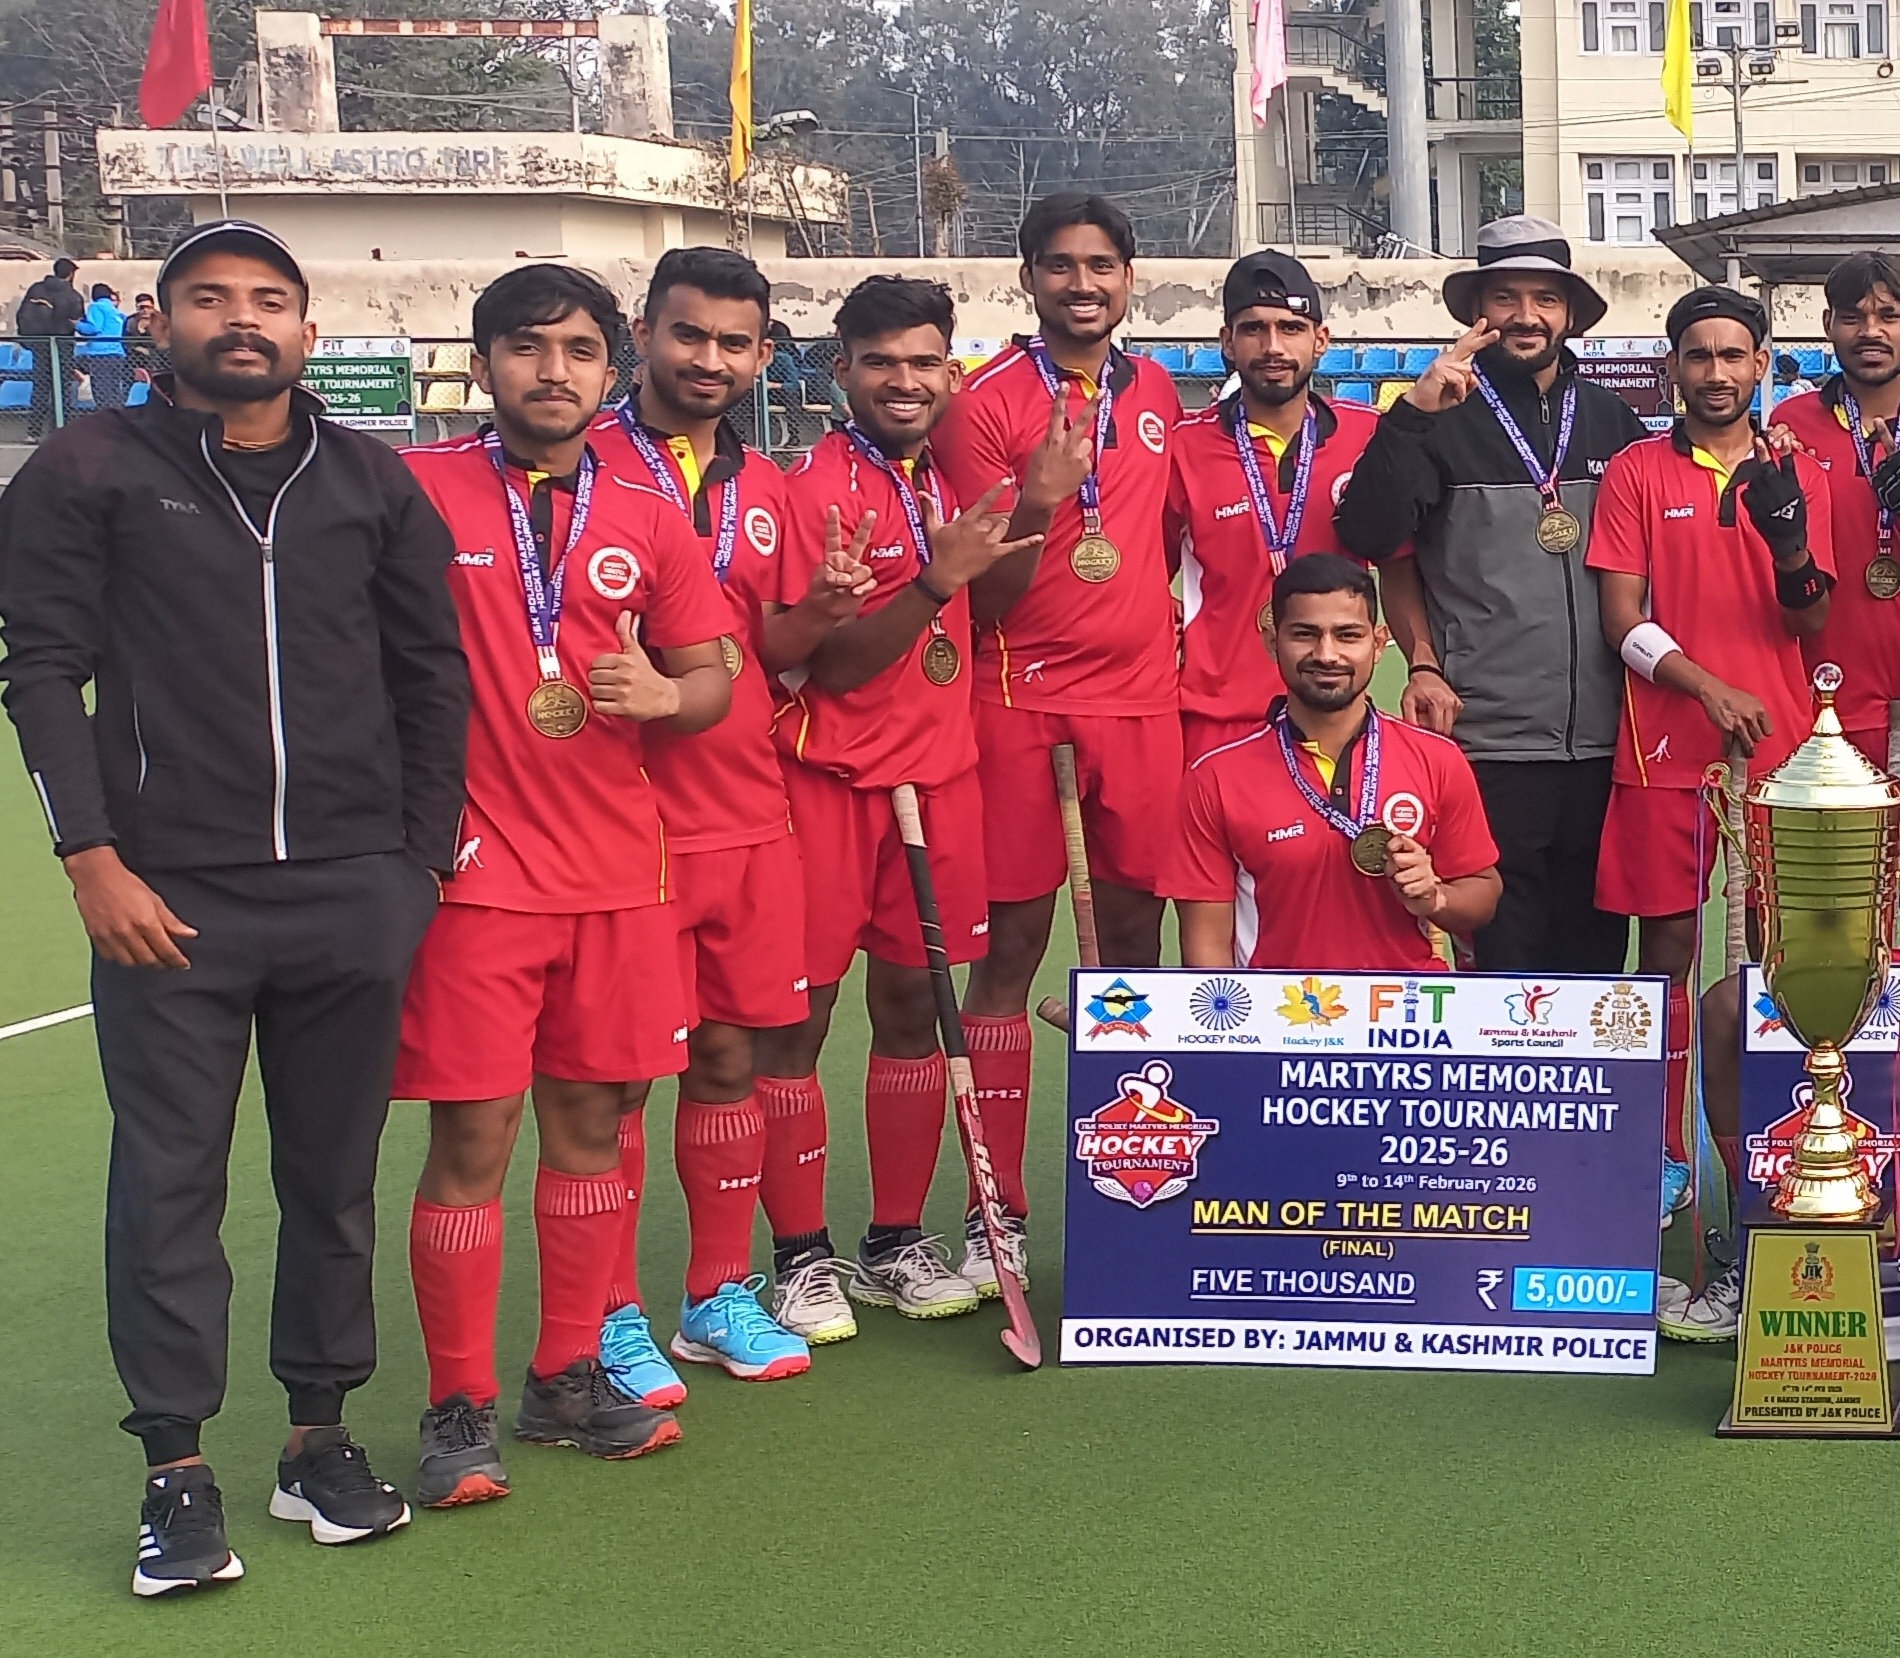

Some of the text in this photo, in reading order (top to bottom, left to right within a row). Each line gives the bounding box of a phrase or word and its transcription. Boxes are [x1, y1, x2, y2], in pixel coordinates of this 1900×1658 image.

[331, 146, 424, 175] ASTRO
[335, 365, 393, 375] MEMORIAL
[1596, 364, 1655, 374] MEMORIAL
[324, 380, 396, 389] TOURNAMENT
[1215, 500, 1249, 519] HMR
[1664, 506, 1694, 519] HMR
[870, 544, 904, 559] HMR
[1268, 823, 1305, 843] HMR
[1178, 1034, 1261, 1045] HOCKEY INDIA
[1368, 1028, 1453, 1049] INDIA
[1479, 1028, 1578, 1039] Jammu & Kashmir
[1853, 1031, 1889, 1041] OCKEY
[1283, 1037, 1345, 1048] Hockey J&K
[1491, 1037, 1564, 1048] Sports Council
[1281, 1061, 1612, 1094] MARTYRS MEMORIAL
[1262, 1097, 1619, 1132] HOCKEY TOURNAMENT
[1081, 1135, 1201, 1156] HOCKEY
[1380, 1135, 1509, 1167] 2025-26
[1093, 1158, 1191, 1172] TOURNAMENT
[1337, 1173, 1537, 1194] 9th to 14th February 2026
[1193, 1200, 1530, 1231] MAN OF THE MATCH
[1322, 1239, 1395, 1260] (FINAL)
[1192, 1270, 1254, 1294] FIVE
[1264, 1271, 1416, 1297] THOUSAND
[1526, 1275, 1638, 1310] 5,000/-
[1759, 1311, 1867, 1338] WINNER
[1074, 1326, 1648, 1360] ORGANISED BY: JAMMU & KASHMIR POLICE
[1783, 1344, 1842, 1354] J&K POLICE
[1761, 1358, 1865, 1368] MARTYRS MEMORIAL
[1749, 1371, 1784, 1381] HOCKEY
[1745, 1407, 1880, 1418] PRESENTED BY J&K POLICE
